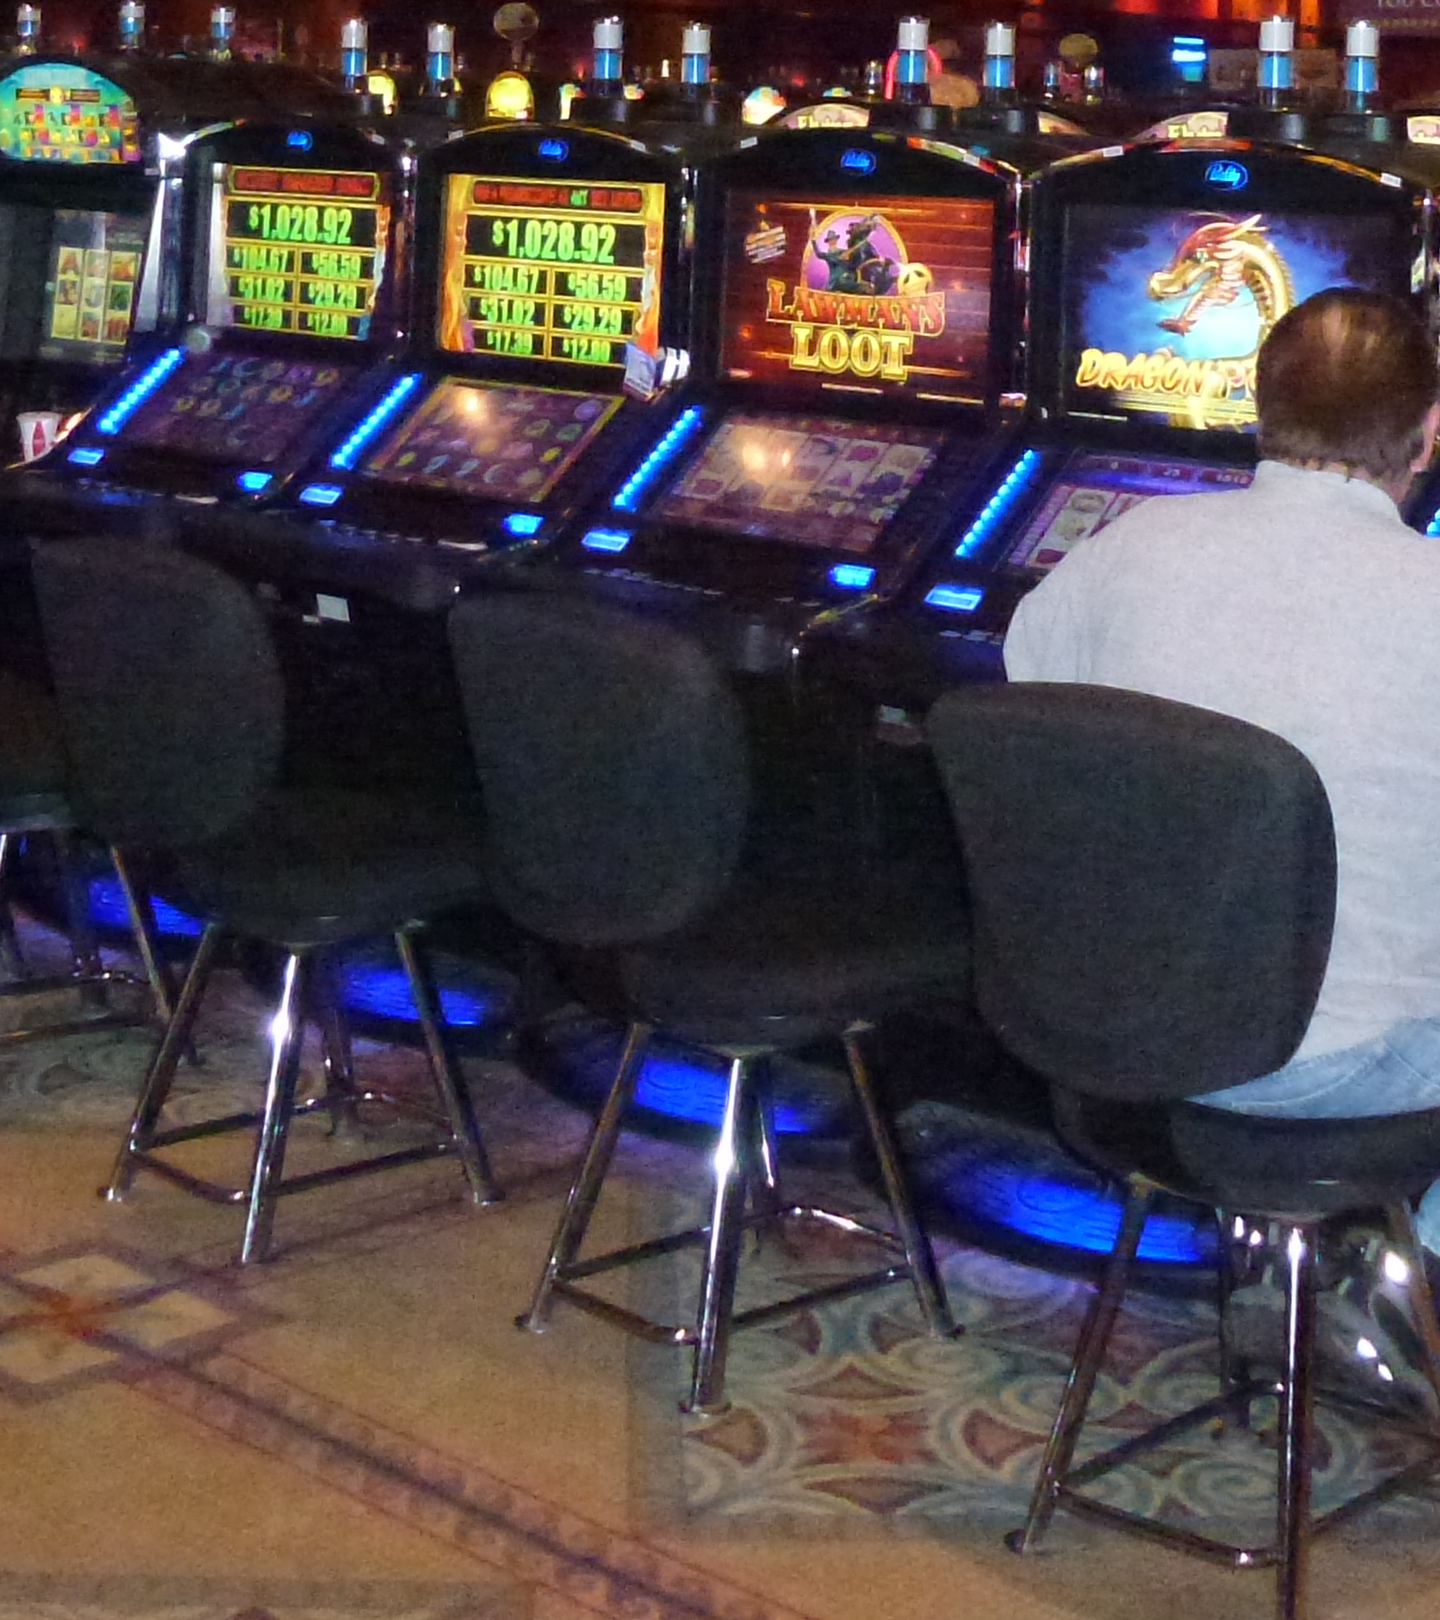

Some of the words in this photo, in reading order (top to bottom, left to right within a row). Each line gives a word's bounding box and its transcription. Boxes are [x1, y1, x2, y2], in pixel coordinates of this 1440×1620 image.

[492, 219, 617, 264] $1,028.92
[474, 266, 539, 294] $104.67
[568, 271, 627, 302] $56.59
[481, 296, 536, 326] $31.02
[563, 304, 623, 336] $29.29
[790, 323, 914, 381] LOOT
[1076, 348, 1206, 396] DRAGON
